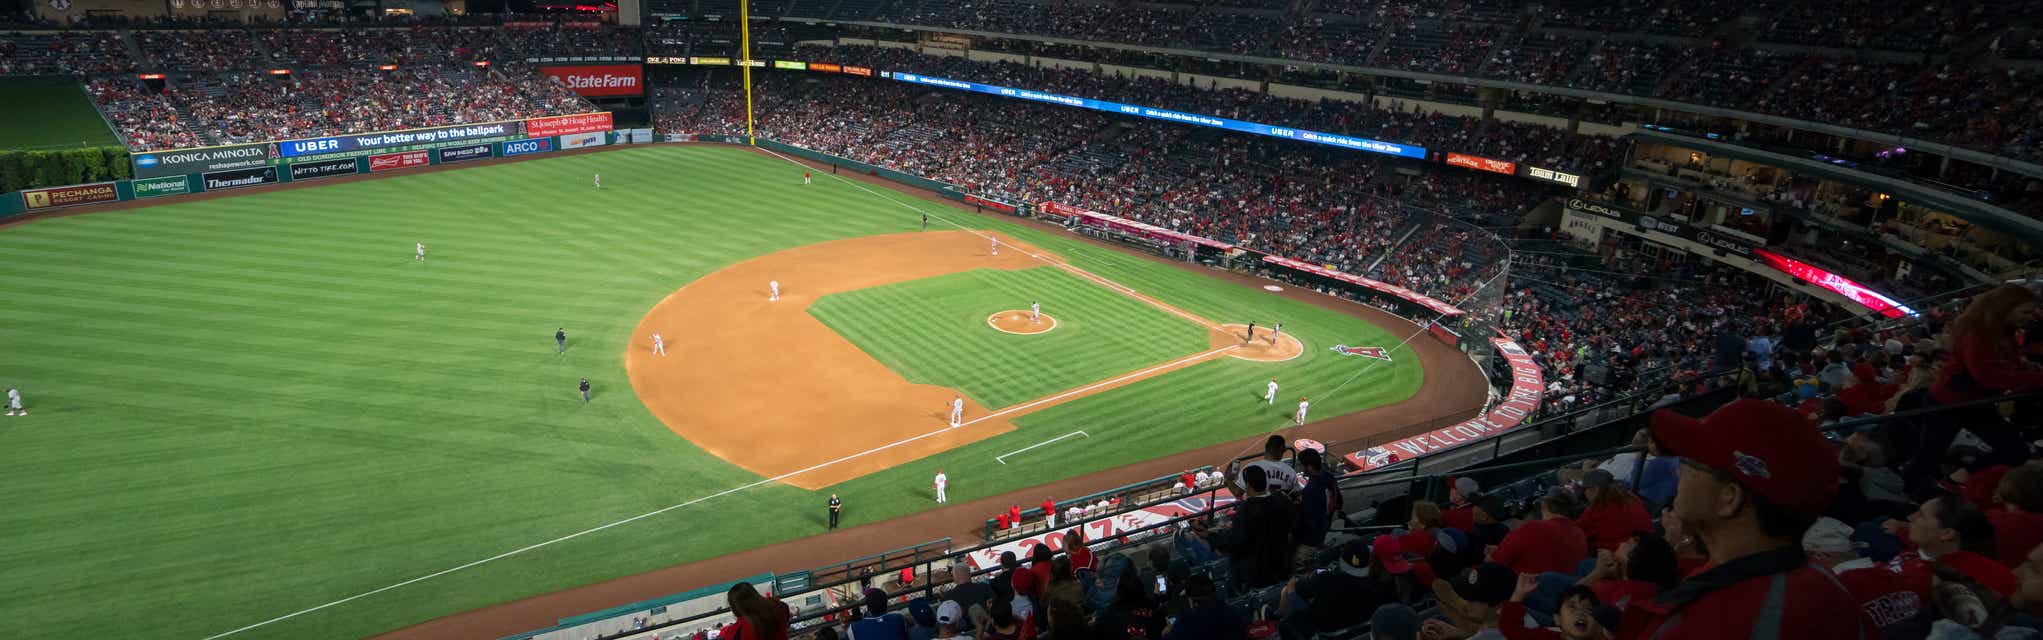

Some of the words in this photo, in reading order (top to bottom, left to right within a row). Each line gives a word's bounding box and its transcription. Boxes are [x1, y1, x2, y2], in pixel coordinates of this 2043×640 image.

[1120, 105, 1139, 114] UBER
[295, 140, 338, 152] UBER
[357, 137, 381, 146] Your
[384, 133, 414, 144] better
[416, 132, 436, 142] way
[438, 130, 448, 138] to
[450, 128, 465, 138] the
[467, 124, 504, 136] ballpark
[1271, 128, 1294, 137] UBER
[506, 142, 538, 153] ARCO
[162, 153, 211, 164] KONICA
[213, 148, 264, 159] MINOLTA
[294, 167, 319, 176] NITTO
[1530, 166, 1553, 179] Team
[1555, 172, 1580, 187] Lally
[148, 180, 184, 191] National
[208, 176, 264, 188] Thermador
[52, 187, 112, 198] PECHANGA
[1583, 204, 1621, 217] LEXUS
[1710, 237, 1749, 254] LEXUS
[1516, 366, 1540, 386] BIG
[1509, 390, 1540, 407] THE
[1494, 405, 1528, 421] TO
[1392, 416, 1504, 456] WELCOME
